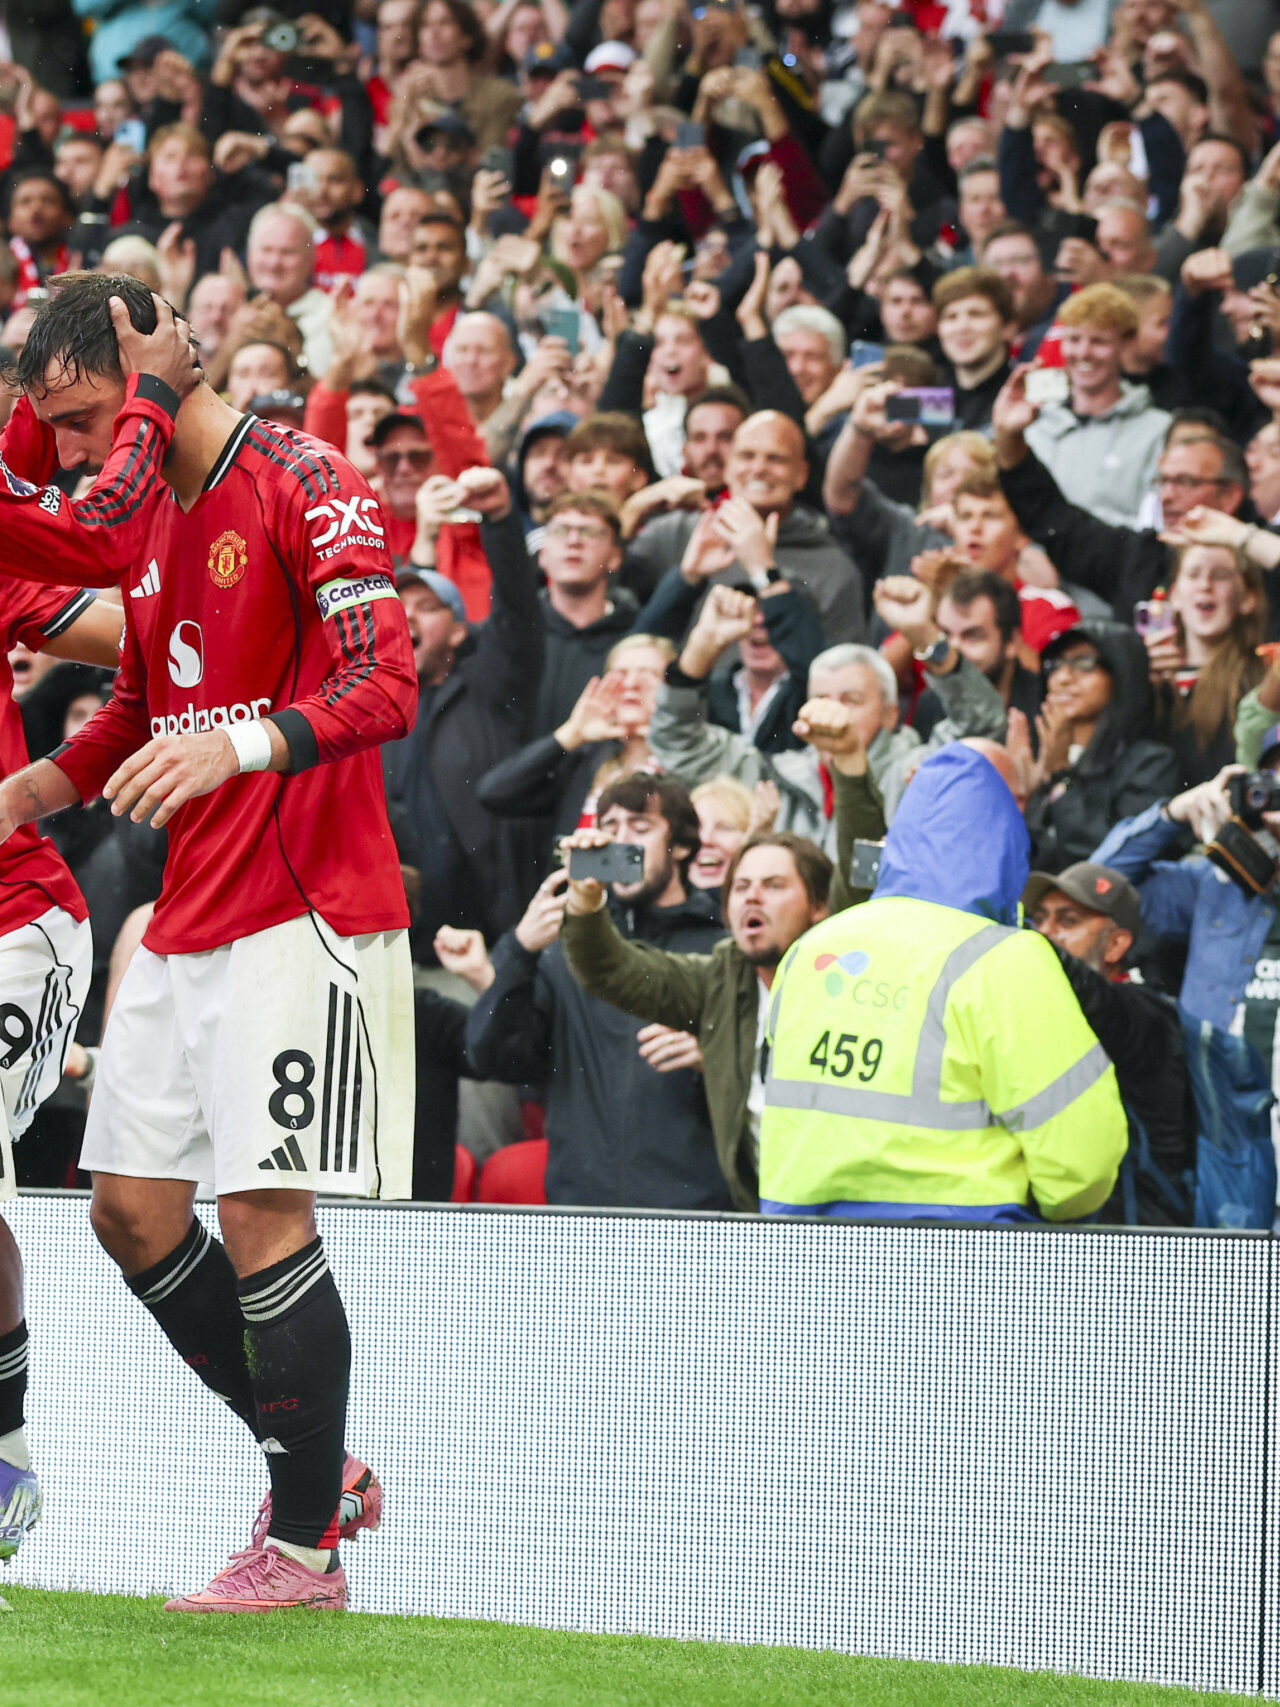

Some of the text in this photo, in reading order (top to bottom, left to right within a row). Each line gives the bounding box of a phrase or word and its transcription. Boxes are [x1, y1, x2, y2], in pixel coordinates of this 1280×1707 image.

[304, 496, 384, 548] DXC
[316, 535, 385, 561] TECHNOLOGY
[150, 697, 272, 740] apdragon
[809, 1030, 883, 1082] 459
[268, 1049, 316, 1130] 8
